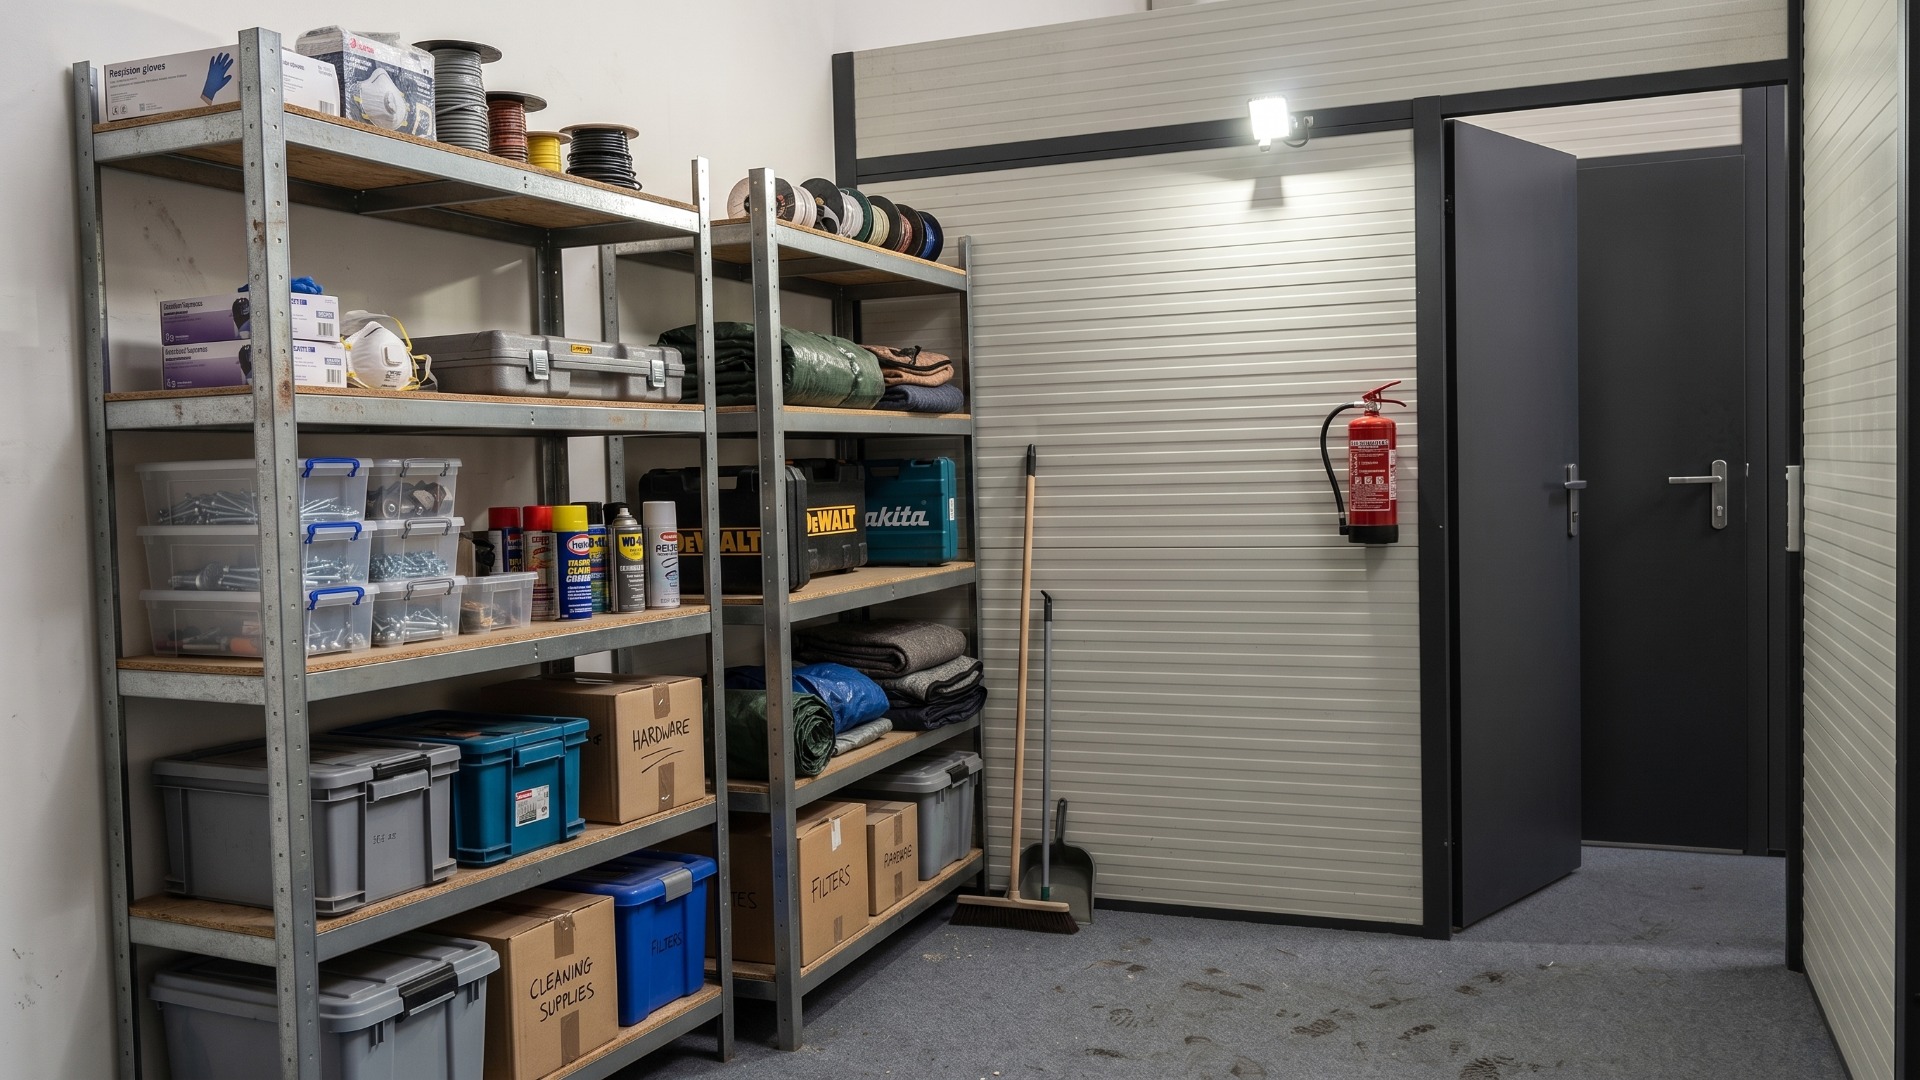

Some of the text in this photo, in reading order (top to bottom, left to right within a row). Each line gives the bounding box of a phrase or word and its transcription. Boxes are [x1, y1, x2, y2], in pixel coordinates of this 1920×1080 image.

[142, 63, 166, 75] gloves
[864, 505, 930, 527] akita
[632, 718, 690, 752] HARDWARE
[811, 864, 851, 904] FILTERS
[651, 931, 682, 957] FILTERS
[530, 956, 593, 1000] CLEANING
[540, 982, 595, 1023] SUPPLIES
